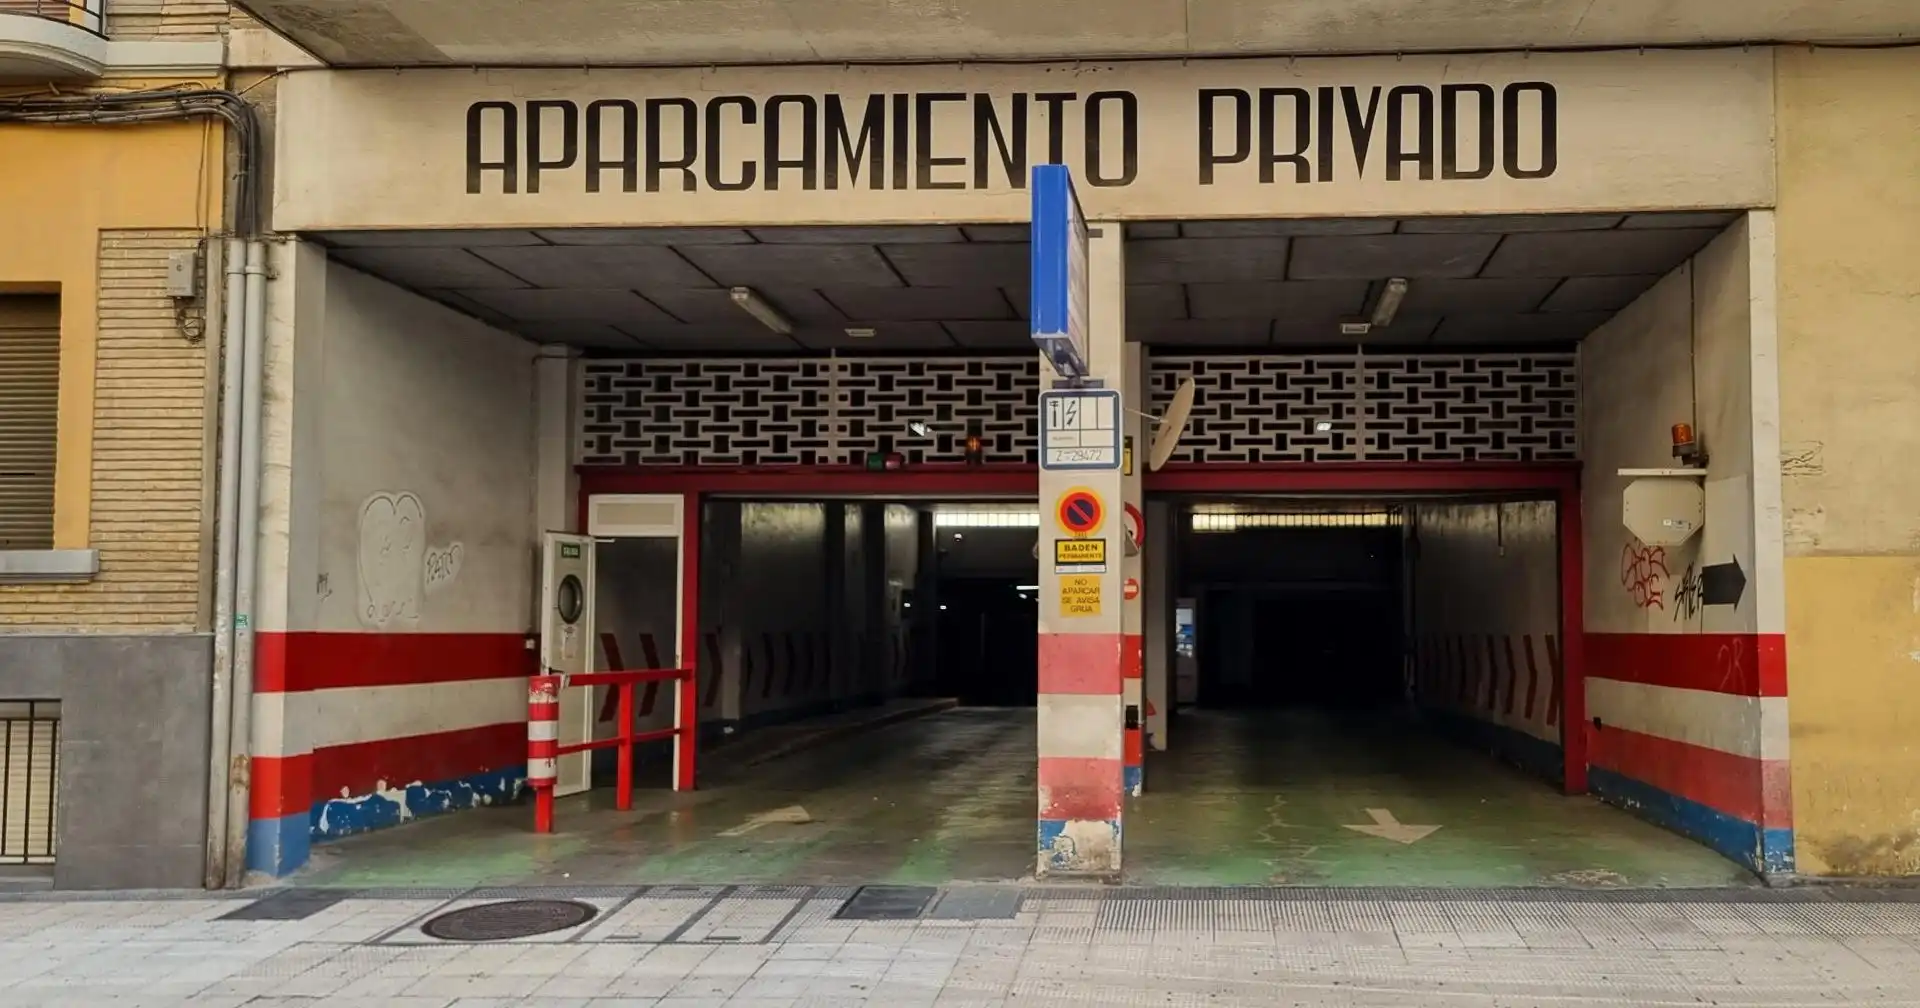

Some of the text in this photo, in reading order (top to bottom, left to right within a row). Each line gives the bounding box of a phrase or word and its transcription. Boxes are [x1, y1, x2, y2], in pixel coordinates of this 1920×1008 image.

[466, 81, 1557, 194] APARCAMIENTO PRIVADO
[1064, 543, 1098, 551] BADEN
[1074, 578, 1088, 586] NO
[1062, 586, 1100, 594] APARCAR
[1062, 596, 1101, 604] SE AVISA
